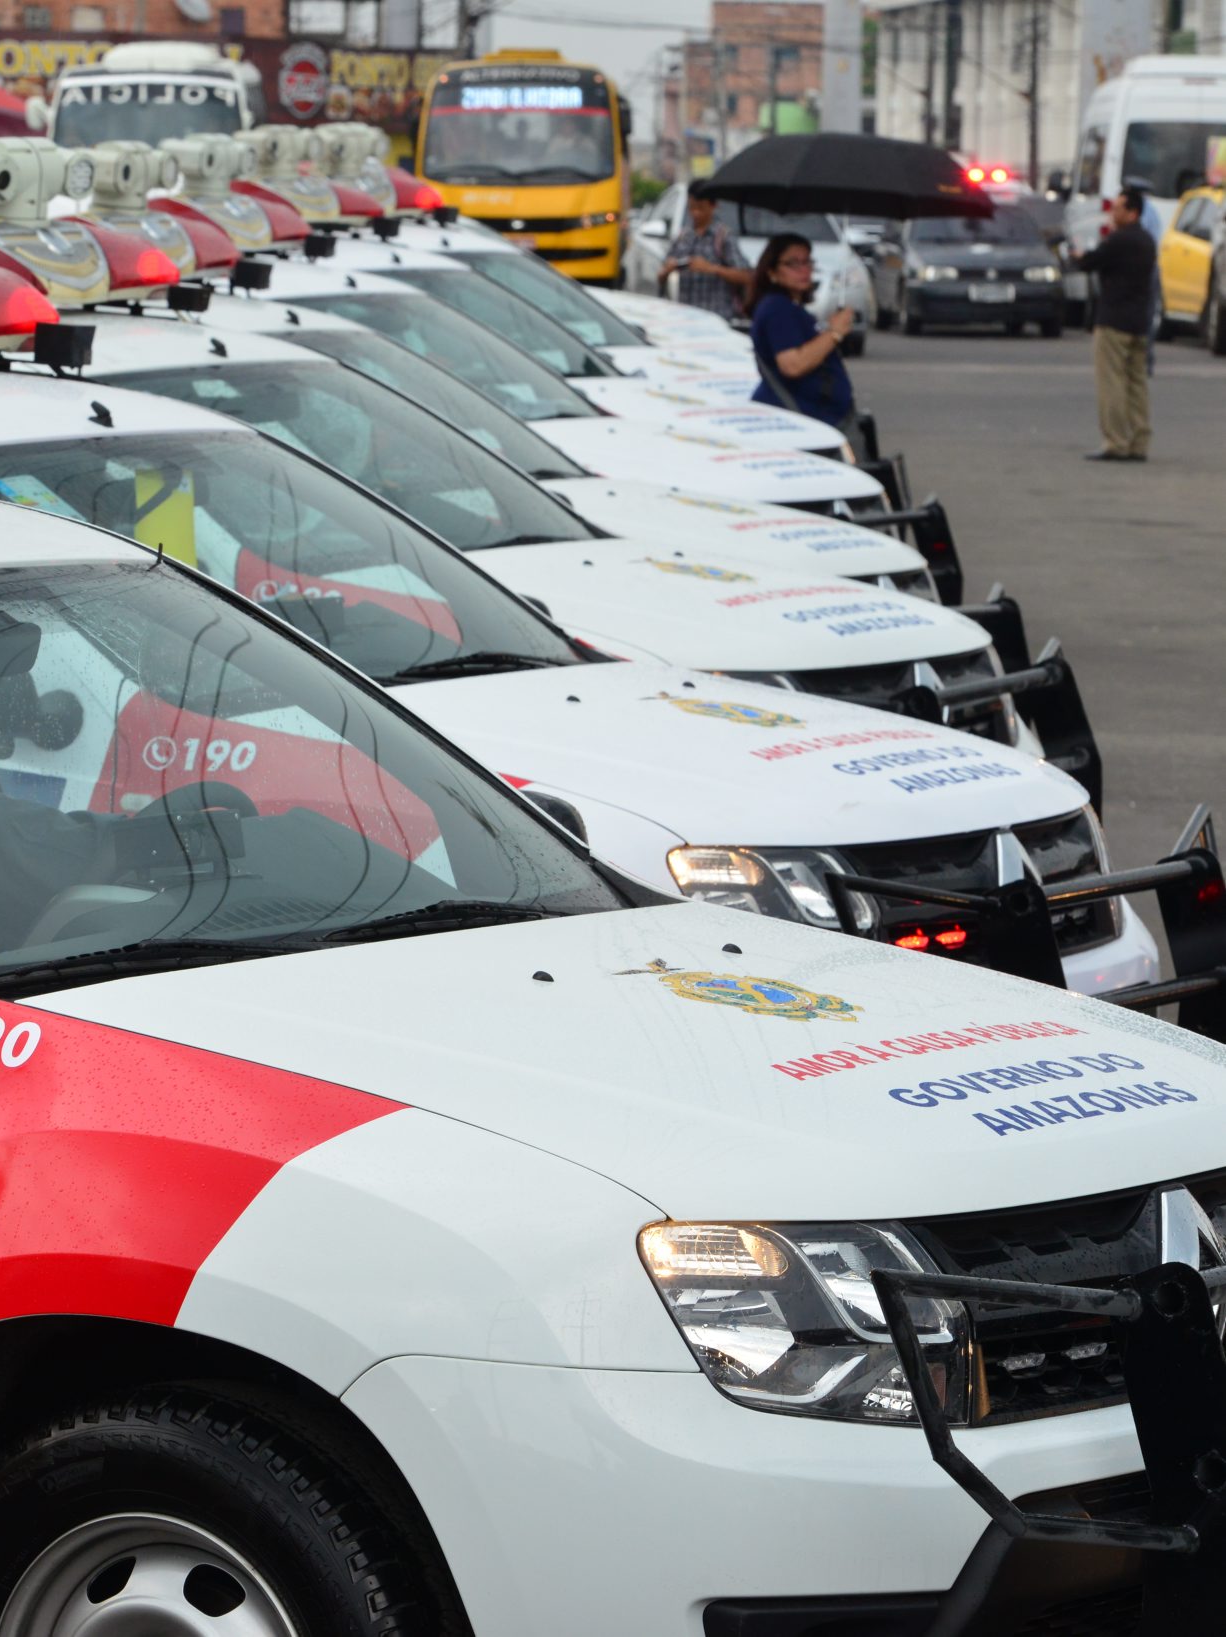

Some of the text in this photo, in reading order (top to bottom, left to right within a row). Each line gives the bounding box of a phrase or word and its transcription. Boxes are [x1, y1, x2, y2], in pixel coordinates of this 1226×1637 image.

[183, 737, 257, 772] 190
[832, 750, 949, 776] GOVERNO
[889, 763, 1022, 794] AMAZONAS
[770, 1021, 1090, 1081] AMOR À CAUSA PÚBLICA
[888, 1052, 1145, 1108] GOVERNO DO
[972, 1081, 1199, 1137] AMAZONAS
